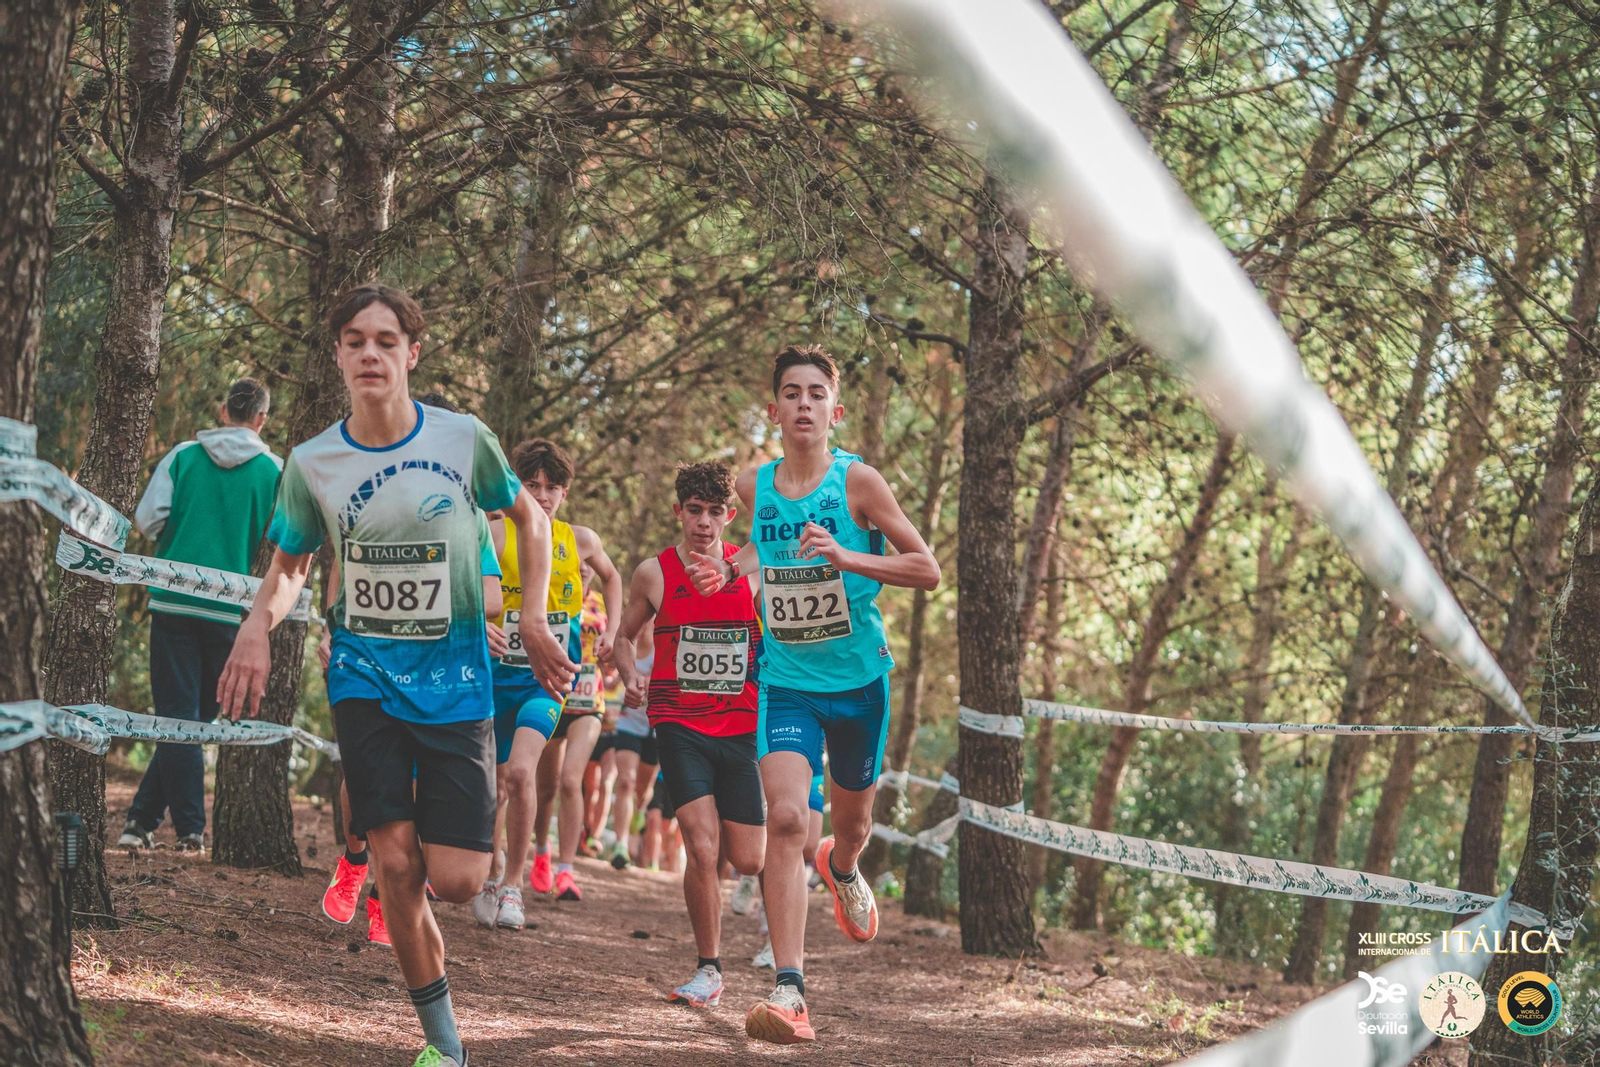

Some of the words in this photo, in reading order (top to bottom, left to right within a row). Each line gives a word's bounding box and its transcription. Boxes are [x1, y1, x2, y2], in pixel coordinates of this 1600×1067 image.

[368, 544, 420, 559] ITÁLICA
[779, 568, 819, 581] ITÁLICA
[354, 578, 442, 612] 8087
[772, 592, 842, 622] 8122
[698, 630, 733, 641] ITÁLICA
[682, 652, 744, 676] 8055
[771, 725, 802, 735] nerja
